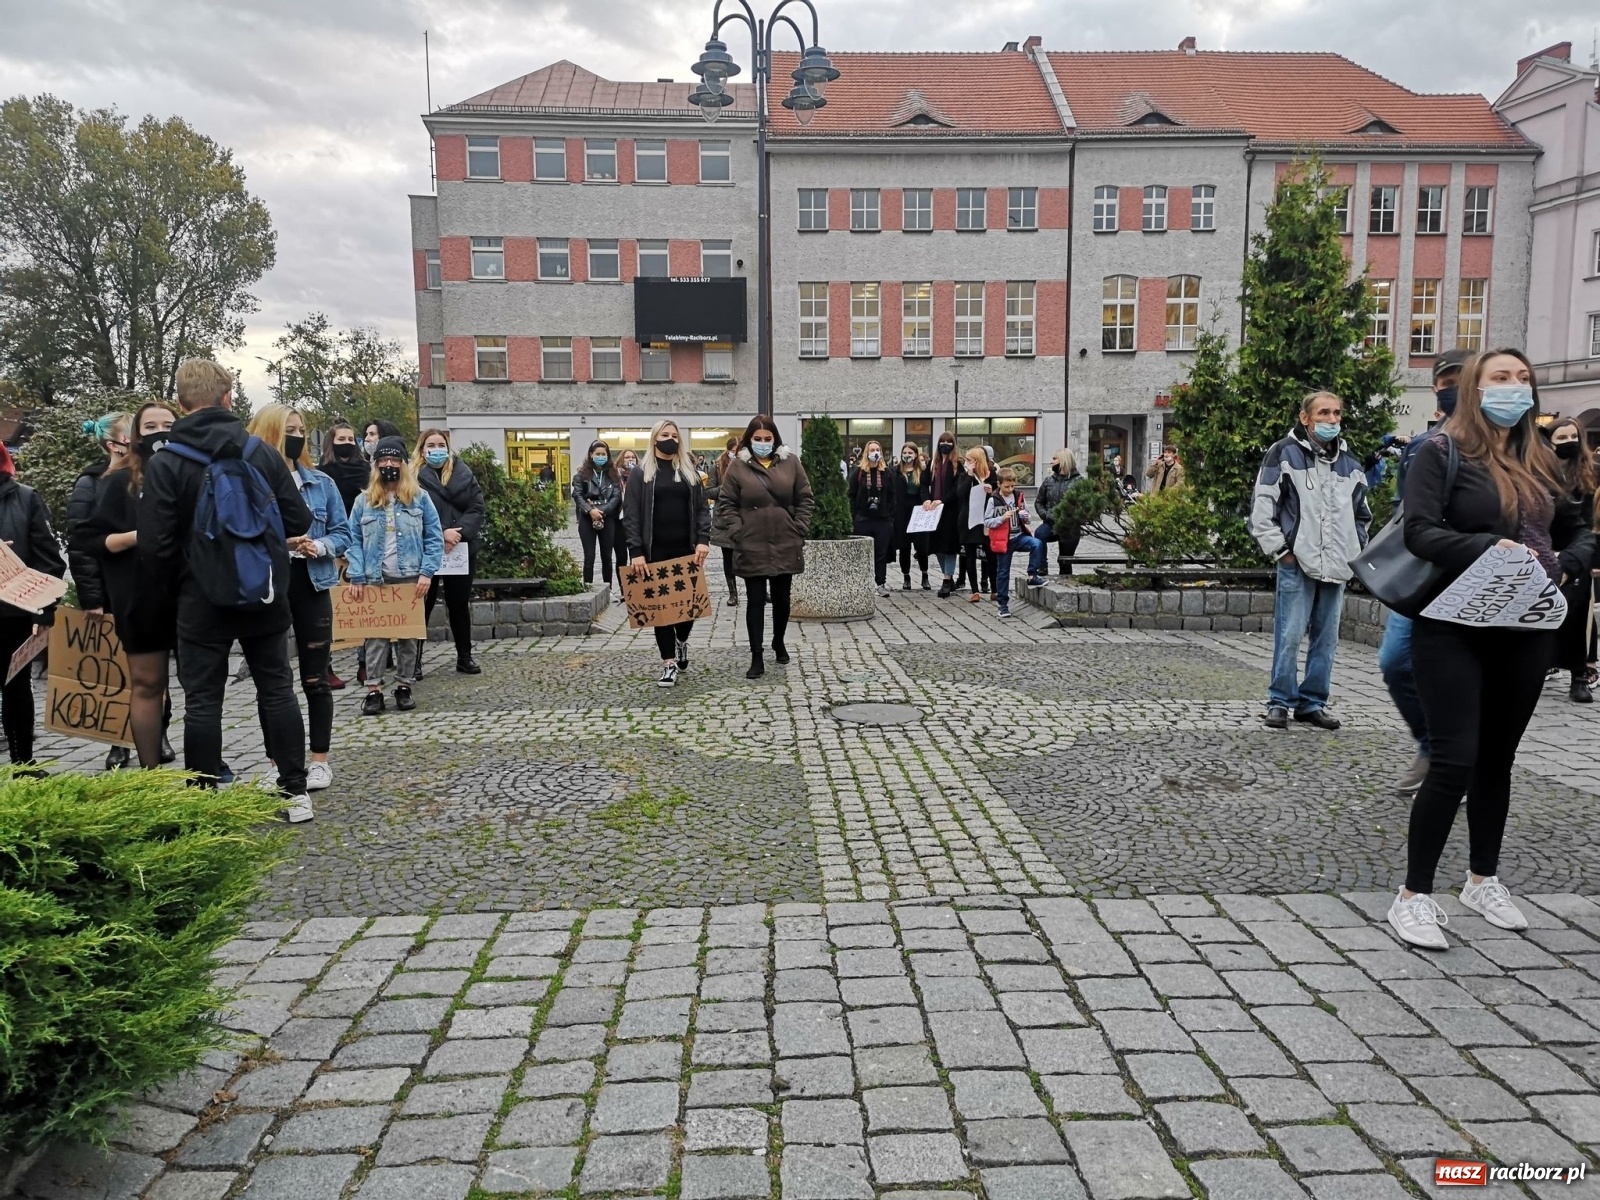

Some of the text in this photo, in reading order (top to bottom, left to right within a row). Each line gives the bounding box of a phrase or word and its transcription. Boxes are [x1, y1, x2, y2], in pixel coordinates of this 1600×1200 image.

[1453, 574, 1514, 622] KOCHAM
[338, 613, 407, 629] THE IMPOSTOR
[348, 605, 375, 616] WAS
[1545, 599, 1566, 623] NIE
[77, 654, 126, 698] OD
